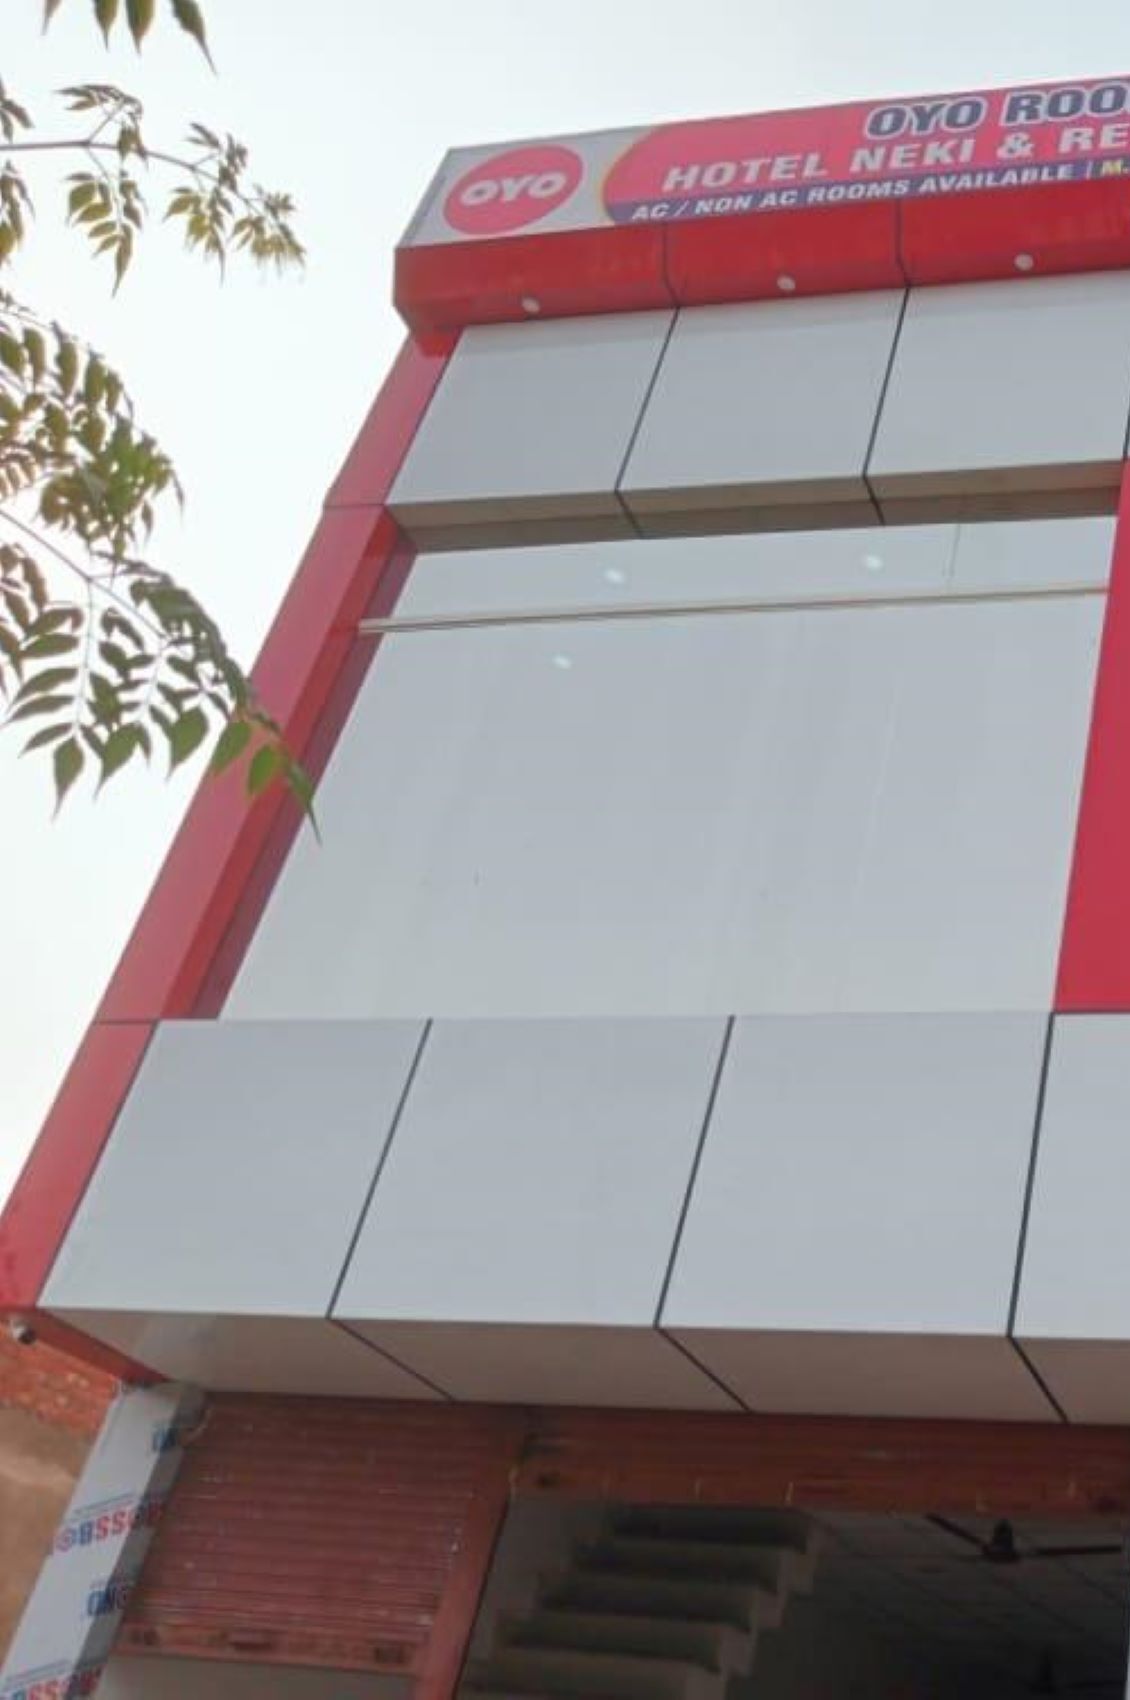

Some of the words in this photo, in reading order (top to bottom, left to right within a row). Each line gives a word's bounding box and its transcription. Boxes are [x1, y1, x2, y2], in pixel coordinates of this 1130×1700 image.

[863, 96, 987, 139] OYO
[662, 152, 827, 192] HOTEL
[850, 139, 975, 172] NEKI
[997, 132, 1034, 158] &
[460, 171, 567, 207] OYO
[632, 202, 669, 221] AC
[695, 195, 752, 214] NON
[759, 190, 798, 209] AC
[808, 179, 908, 203] ROOMS
[919, 164, 1073, 192] AVAILABLE
